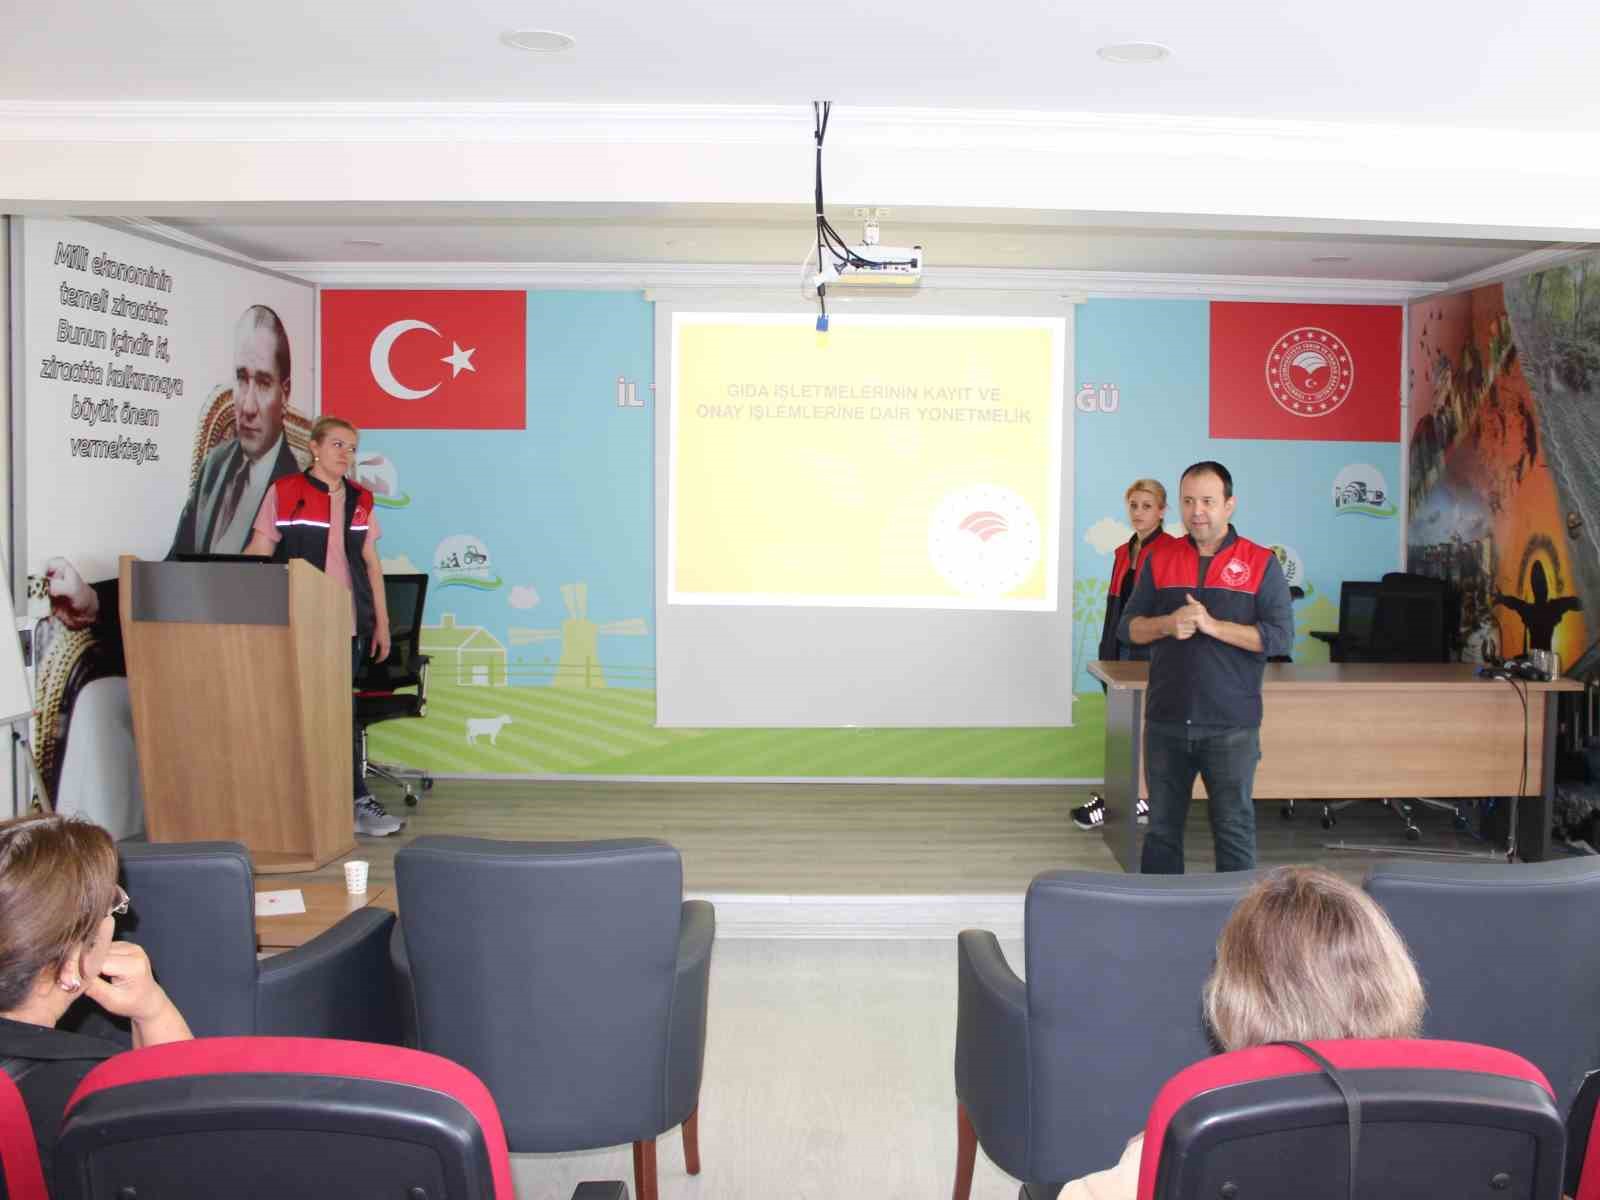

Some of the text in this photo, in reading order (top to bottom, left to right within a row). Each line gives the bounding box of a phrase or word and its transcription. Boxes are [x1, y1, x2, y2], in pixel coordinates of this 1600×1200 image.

[91, 252, 173, 293] ekonominin
[60, 281, 109, 313] temeli
[57, 318, 170, 363] Bunun içindir ki,
[40, 355, 185, 399] ziraatta kalkınmaya
[617, 376, 645, 407] İL
[727, 383, 768, 398] GIDA
[923, 386, 973, 401] KAYIT
[977, 386, 1001, 402] VE
[70, 393, 160, 427] büyük önem
[695, 404, 744, 420] ONAY
